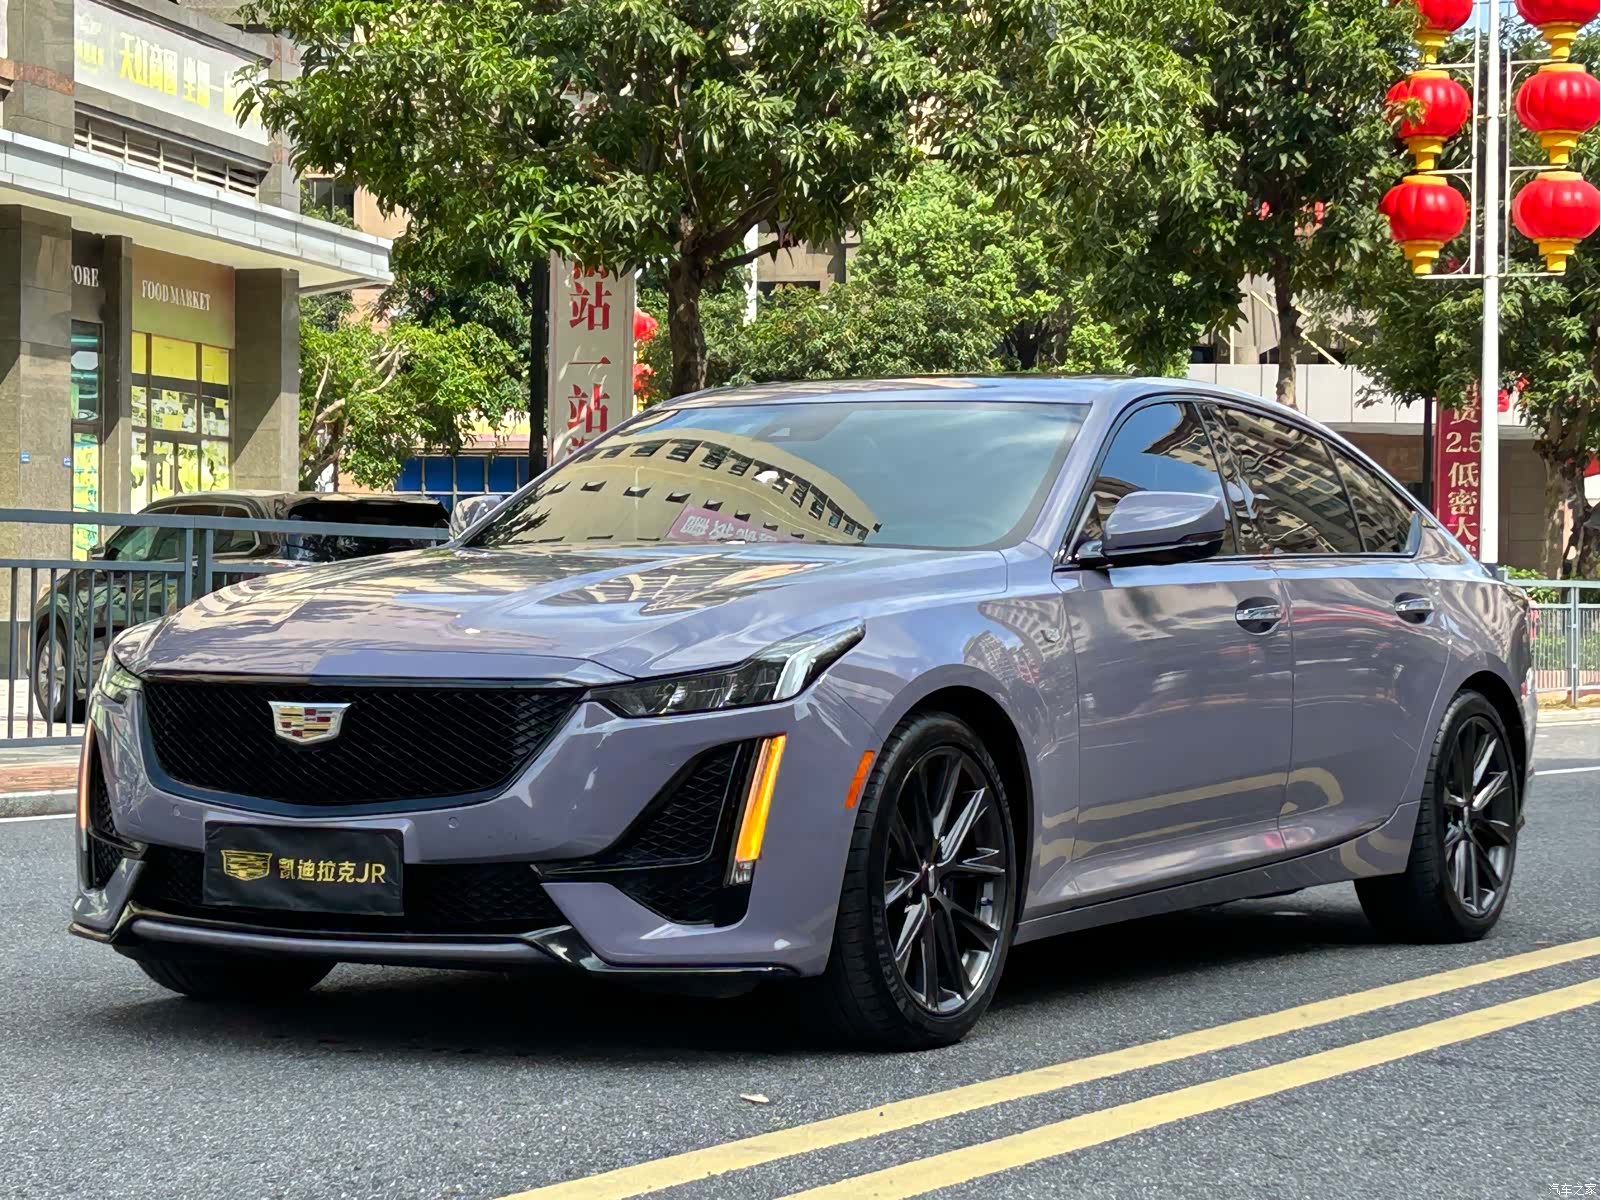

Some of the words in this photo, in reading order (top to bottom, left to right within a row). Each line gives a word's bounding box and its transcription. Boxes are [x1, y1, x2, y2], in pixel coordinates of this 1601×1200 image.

[72, 264, 99, 288] ORE
[142, 280, 169, 302] FOOD
[170, 286, 211, 311] MARKET
[567, 261, 613, 453] 站一站
